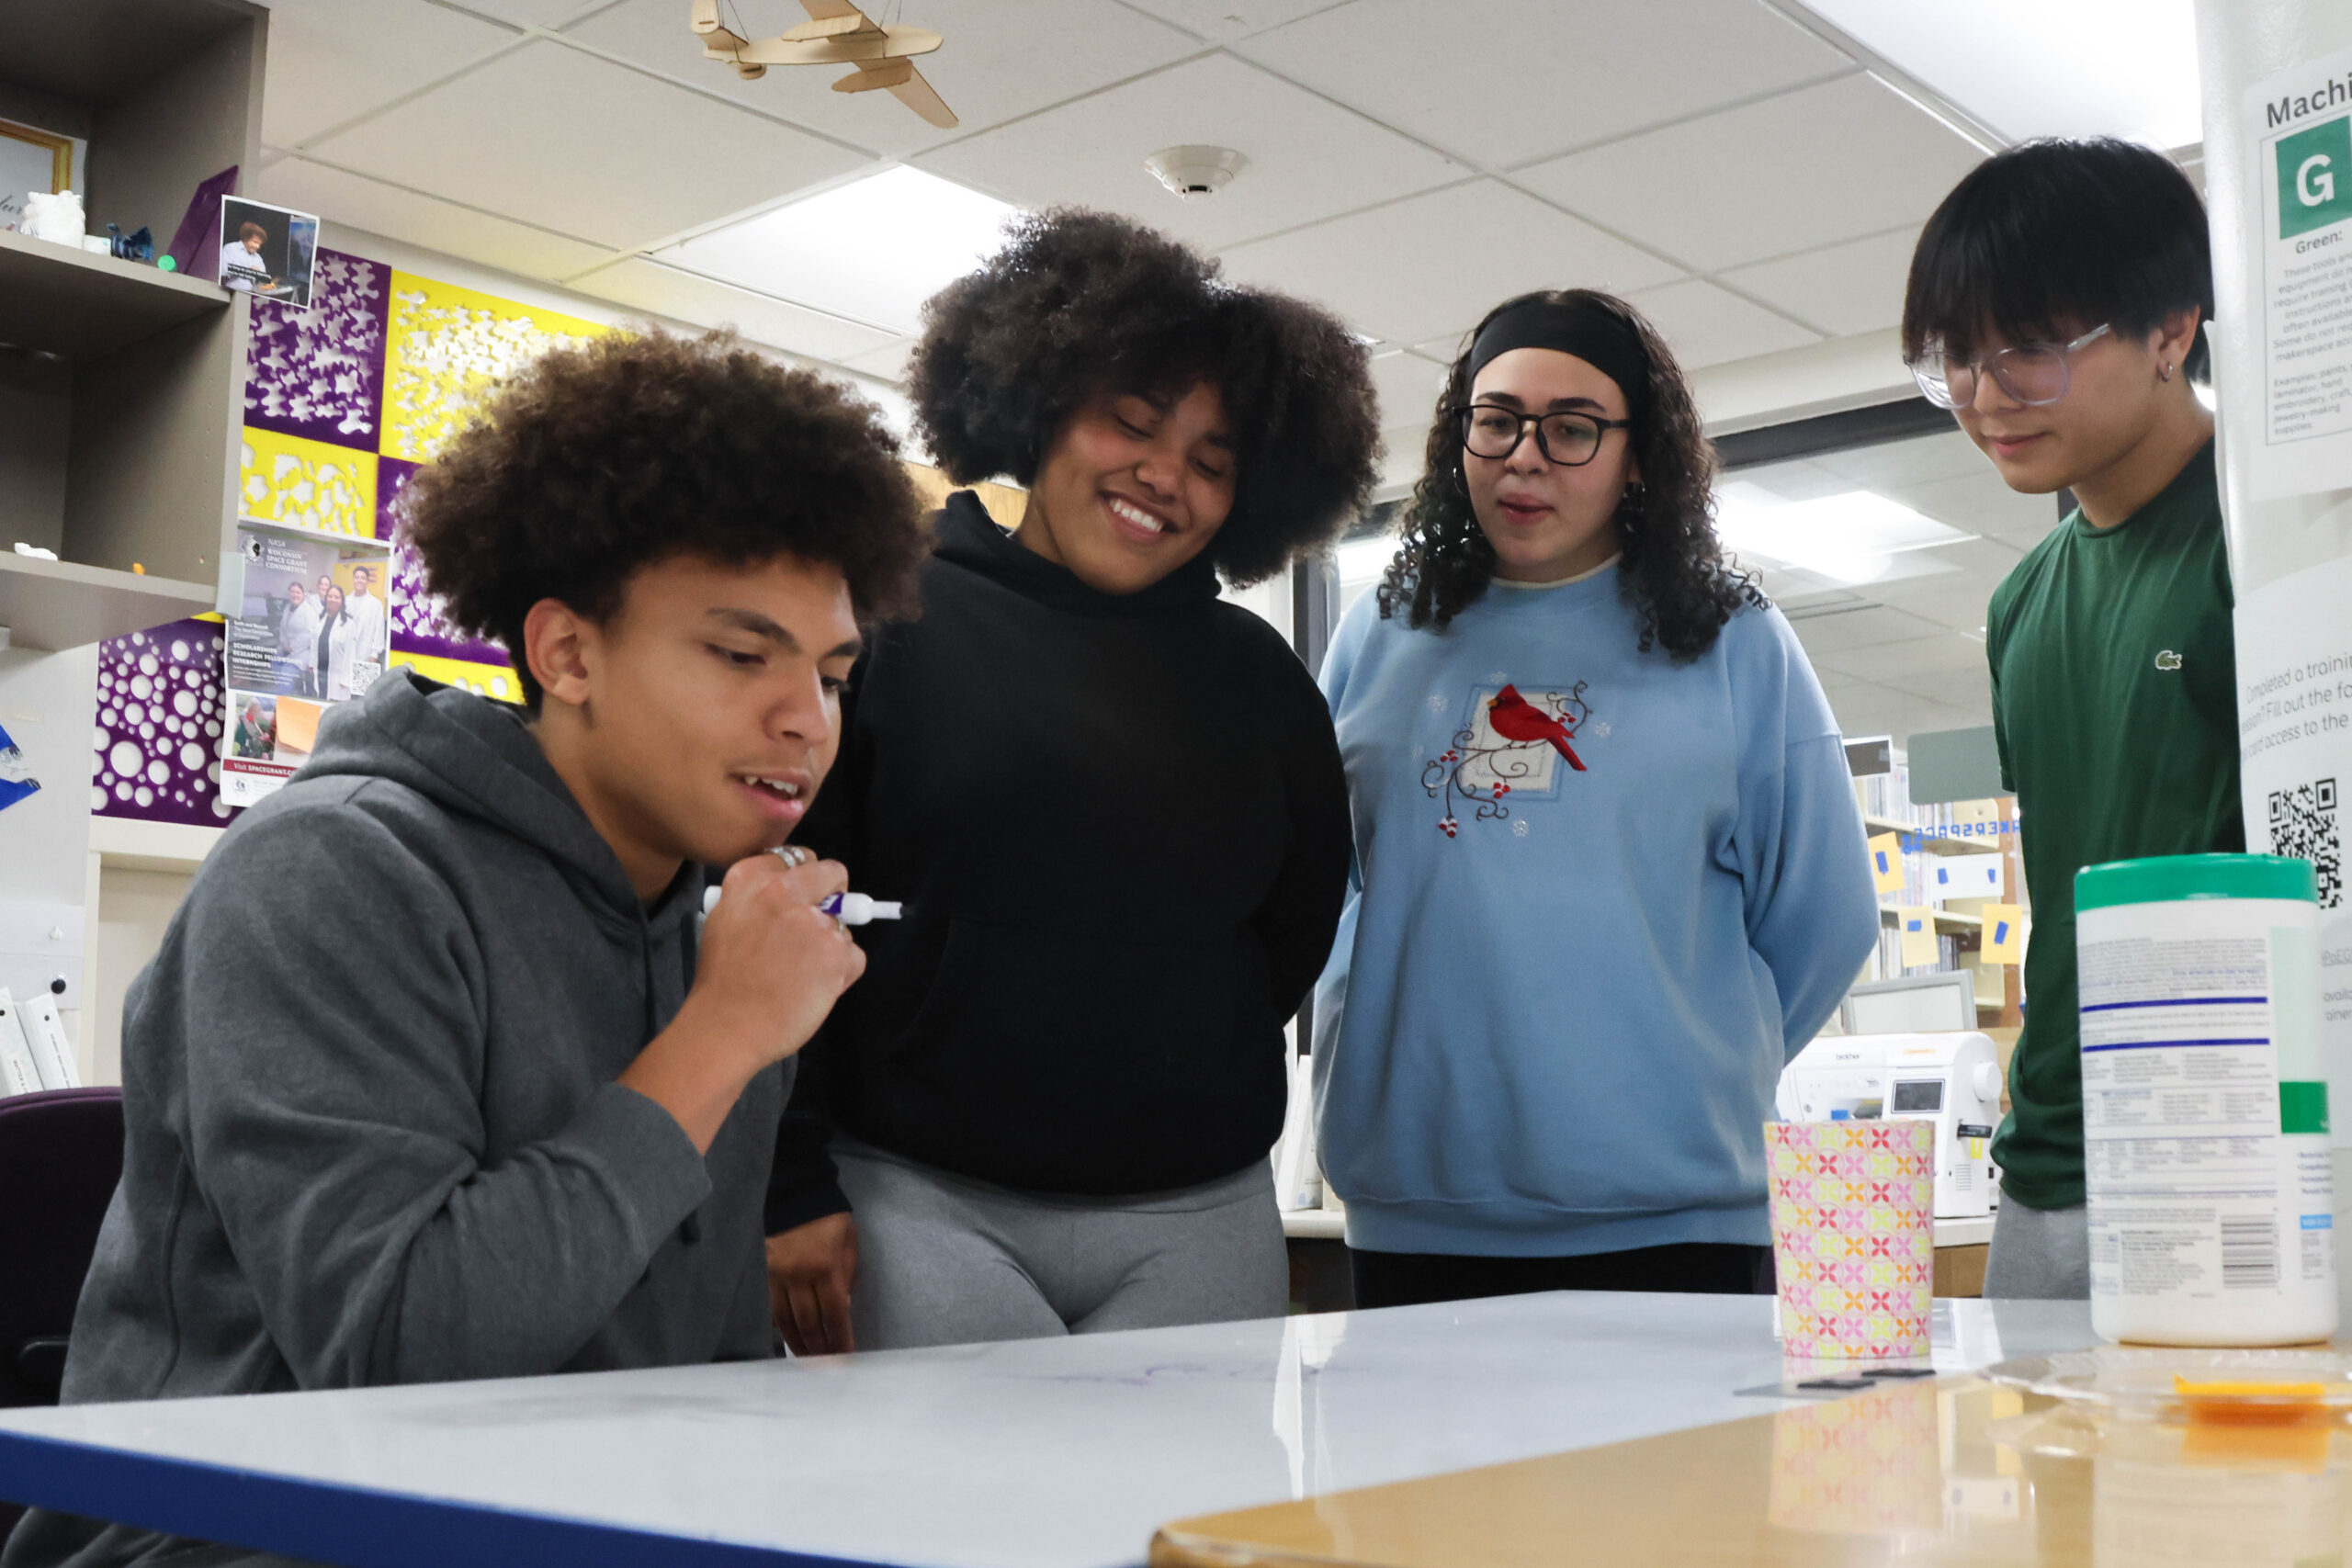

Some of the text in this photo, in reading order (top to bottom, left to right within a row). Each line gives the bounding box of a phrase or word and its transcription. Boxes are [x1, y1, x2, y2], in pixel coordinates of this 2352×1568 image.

[2297, 153, 2335, 208] G
[2295, 230, 2343, 254] Green:
[2284, 265, 2311, 277] These
[2312, 257, 2336, 271] tools
[2278, 273, 2329, 294] equipment
[2331, 269, 2345, 279] do
[2274, 282, 2347, 309] require training
[2285, 299, 2342, 319] instructions
[2283, 321, 2310, 333] often
[2273, 336, 2302, 349] Some
[2304, 333, 2316, 343] do
[2319, 327, 2335, 336] not
[2276, 342, 2335, 362] makerspace
[2321, 378, 2343, 389] hand
[267, 537, 287, 548] NASA
[266, 548, 303, 560] WISCONSIN
[266, 555, 309, 569] SPACE GRANT
[266, 561, 308, 575] CONSORTIUM
[232, 641, 278, 655] SCHOLARSHIPS
[232, 649, 264, 660] RESEARCH
[232, 656, 272, 669] INTERNSHIPS
[2295, 669, 2304, 682] a
[2267, 699, 2282, 720] Fill
[2284, 693, 2306, 715] out
[2308, 686, 2333, 706] the
[2265, 726, 2301, 750] access
[2303, 720, 2319, 737] to
[2322, 713, 2350, 732] the
[233, 761, 295, 777] Visit SPACEGRANT.C
